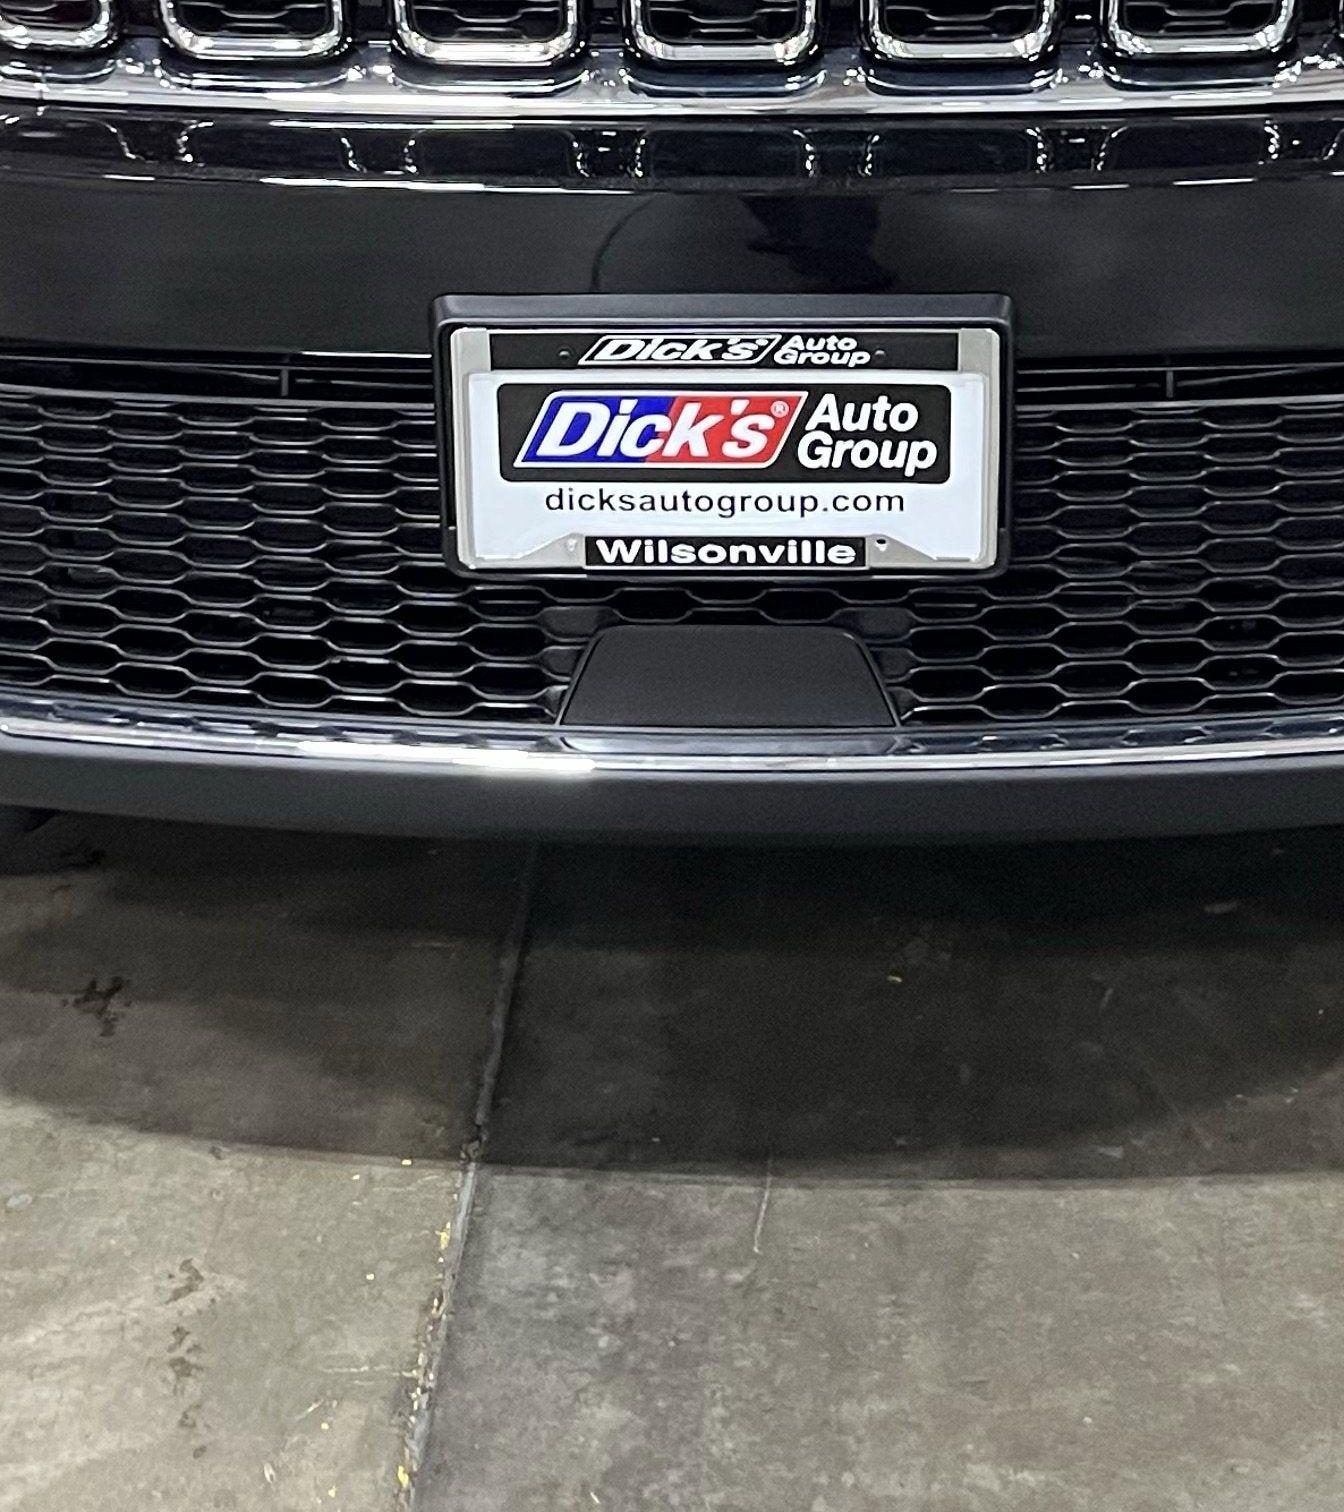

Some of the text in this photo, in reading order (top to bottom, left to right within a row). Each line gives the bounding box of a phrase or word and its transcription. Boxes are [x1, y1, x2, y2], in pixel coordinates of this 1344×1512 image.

[780, 334, 858, 351] Auto
[773, 349, 871, 368] Group
[805, 392, 919, 433] Auto
[797, 431, 938, 478] Group
[544, 488, 906, 518] dicksautogroup.com
[595, 539, 857, 565] Wilsonville
